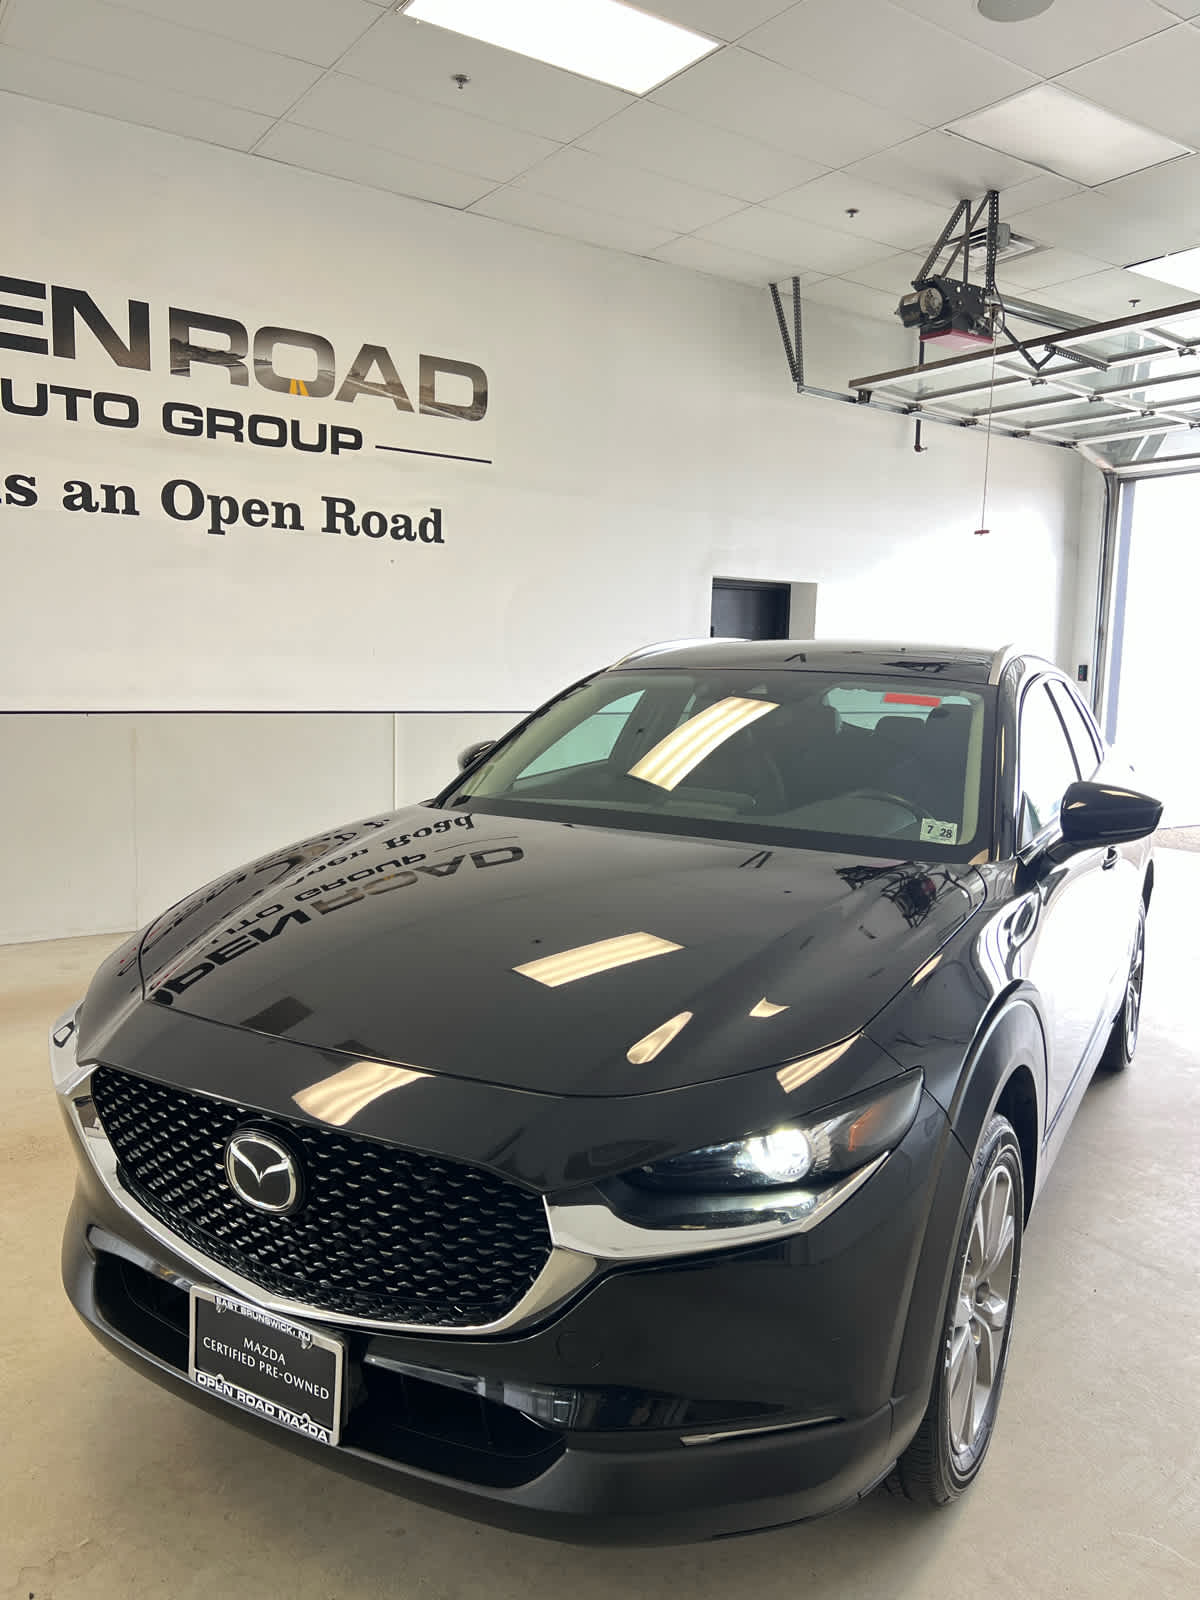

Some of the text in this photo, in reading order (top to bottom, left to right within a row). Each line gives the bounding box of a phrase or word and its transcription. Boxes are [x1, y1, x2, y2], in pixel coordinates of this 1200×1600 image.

[169, 306, 489, 422] ROAD
[162, 401, 362, 455] GROUP
[62, 478, 140, 516] an
[160, 479, 305, 535] Open
[320, 495, 445, 544] Road
[927, 824, 953, 839] 7 28
[215, 1296, 240, 1313] EAST
[298, 1331, 311, 1342] NJ
[203, 1336, 330, 1400] CERTIFIED PRE-OWNED
[243, 1337, 286, 1366] MAZDA
[197, 1374, 328, 1443] OPEN ROAD MAZDA
